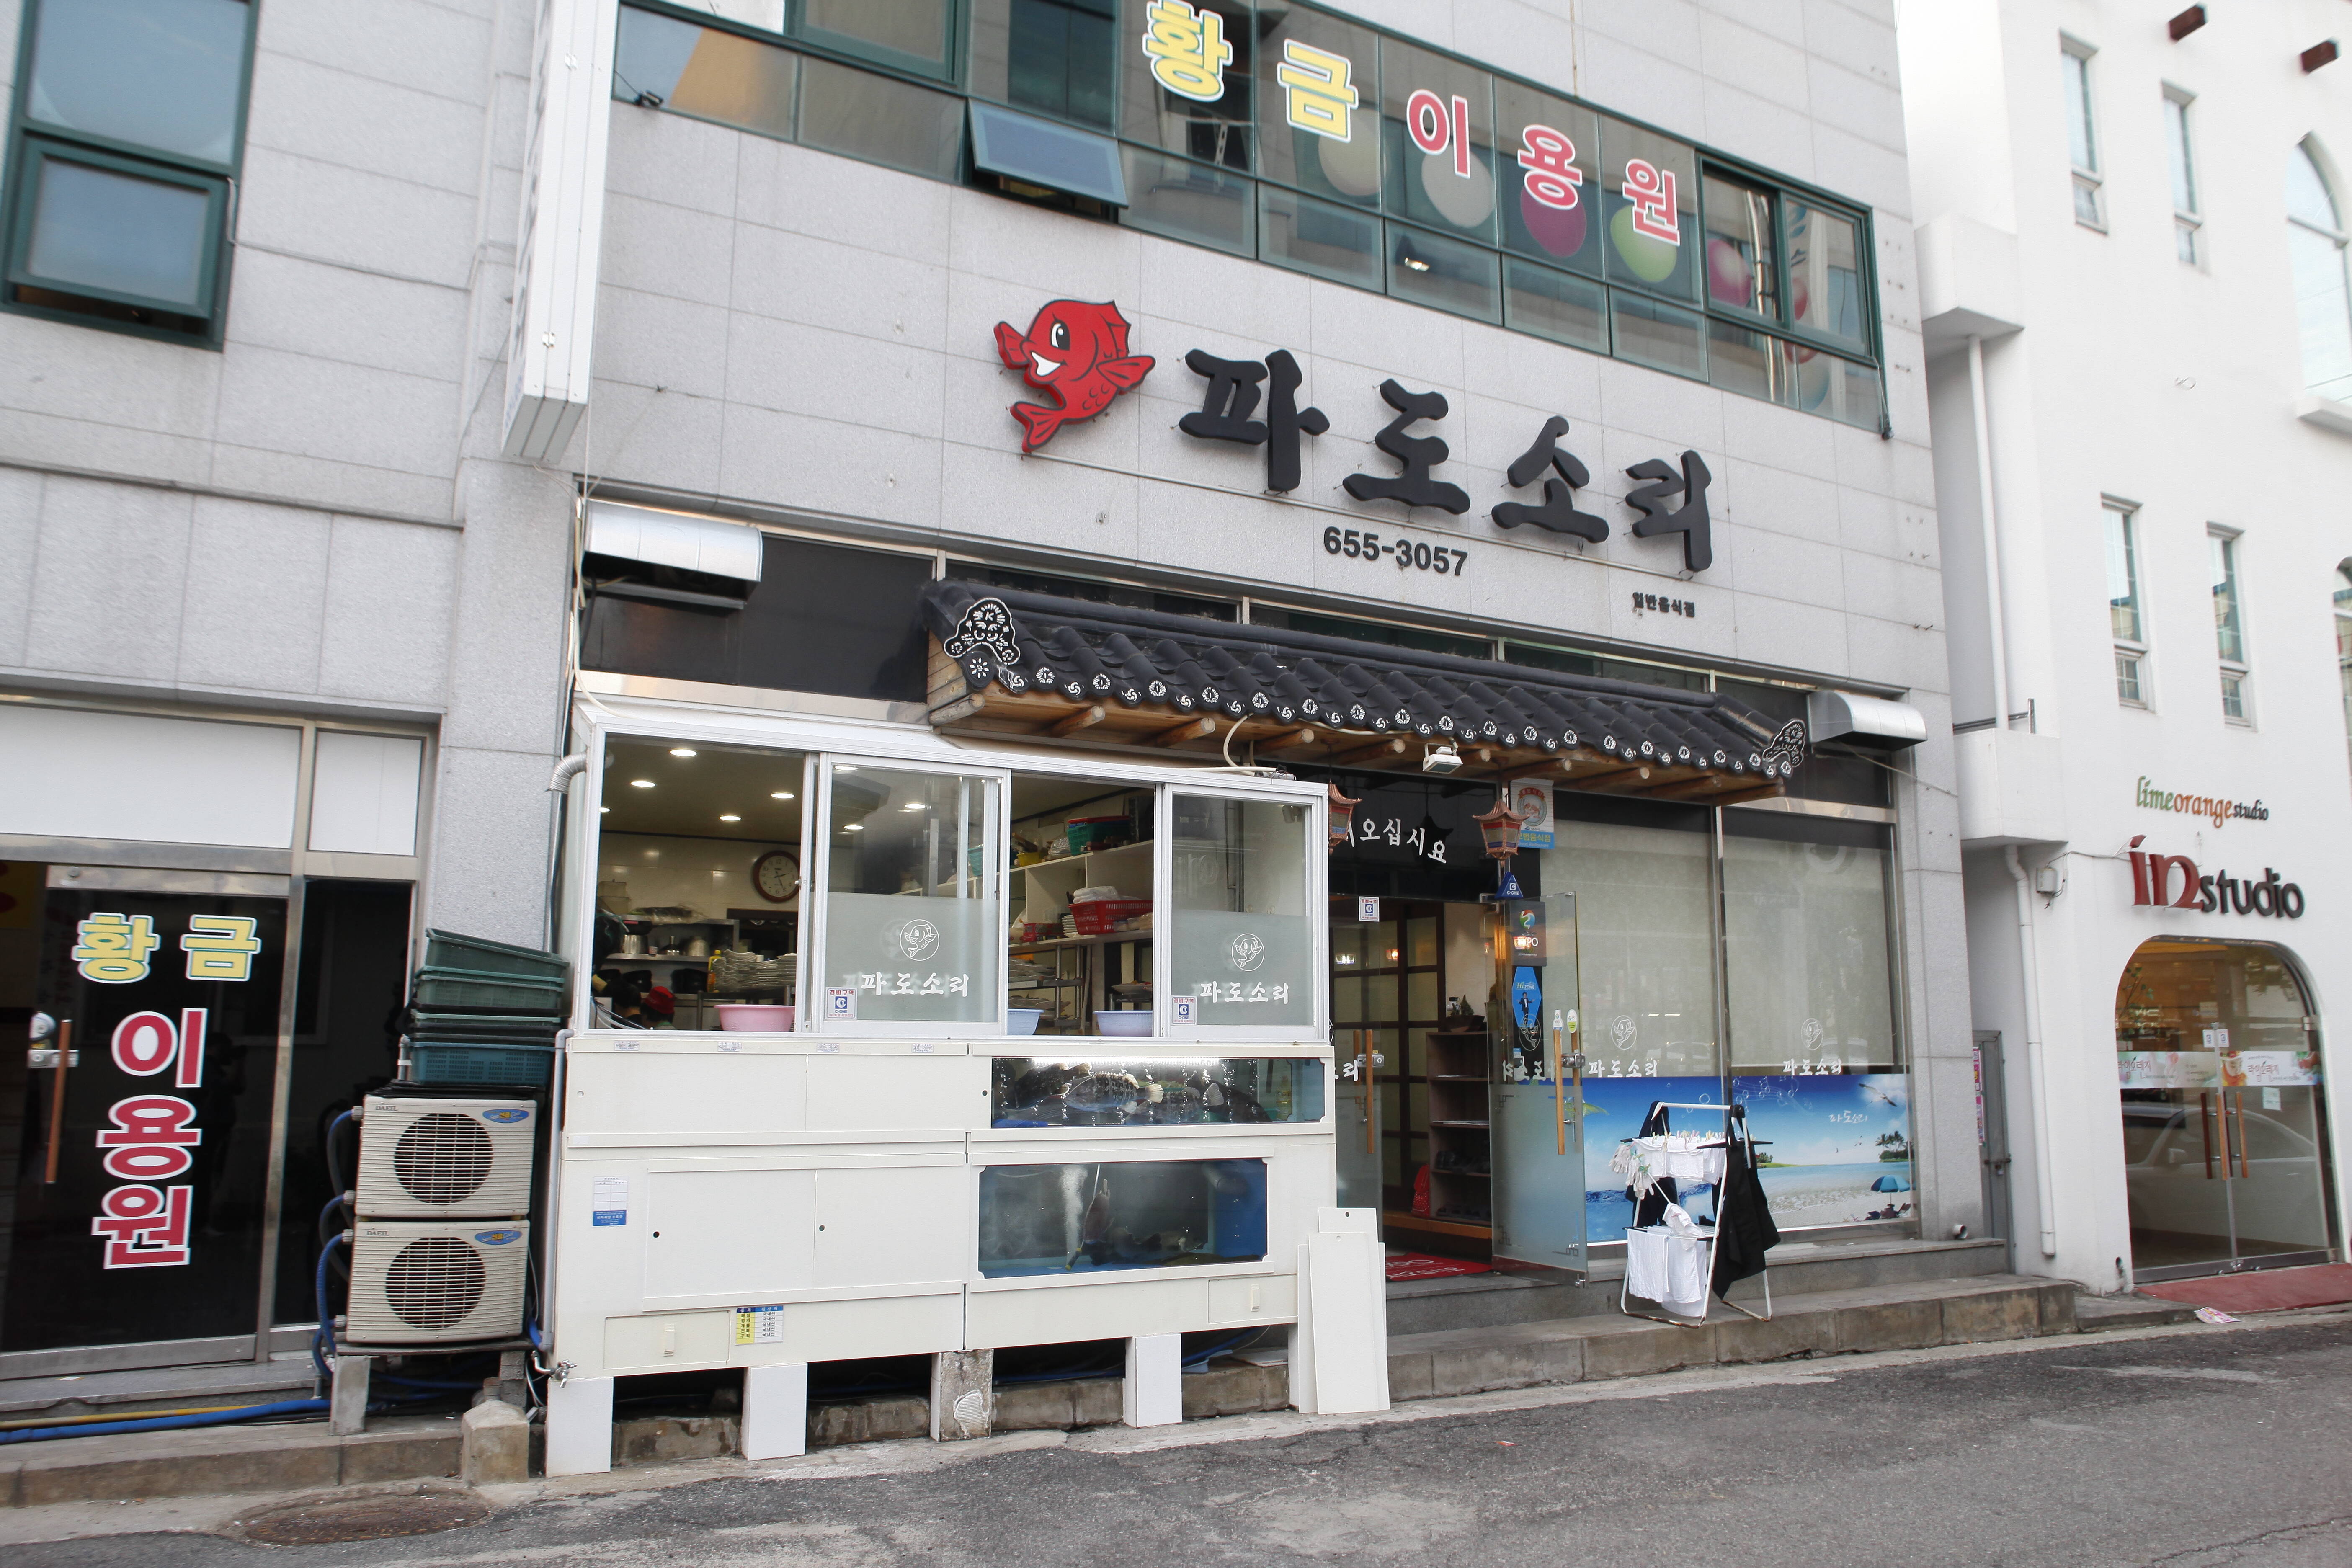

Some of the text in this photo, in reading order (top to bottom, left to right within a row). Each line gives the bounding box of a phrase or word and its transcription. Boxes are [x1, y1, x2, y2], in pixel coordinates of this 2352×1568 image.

[1142, 0, 1680, 246] 황금 이용원
[1179, 348, 1712, 572] 파도소리
[1323, 526, 1468, 576] 655-3057
[1632, 592, 1695, 617] 일반음식점
[1346, 818, 1447, 864] 오십시요
[71, 912, 261, 984] 황금
[1518, 937, 1538, 947] PO
[861, 972, 970, 997] 파도소리
[1200, 981, 1289, 1004] 파도소리
[1588, 1059, 1657, 1078] 파도소리
[1783, 1058, 1841, 1076] 파도소리
[1828, 1110, 1869, 1124] 파도소리
[91, 1007, 208, 1269] 이용원
